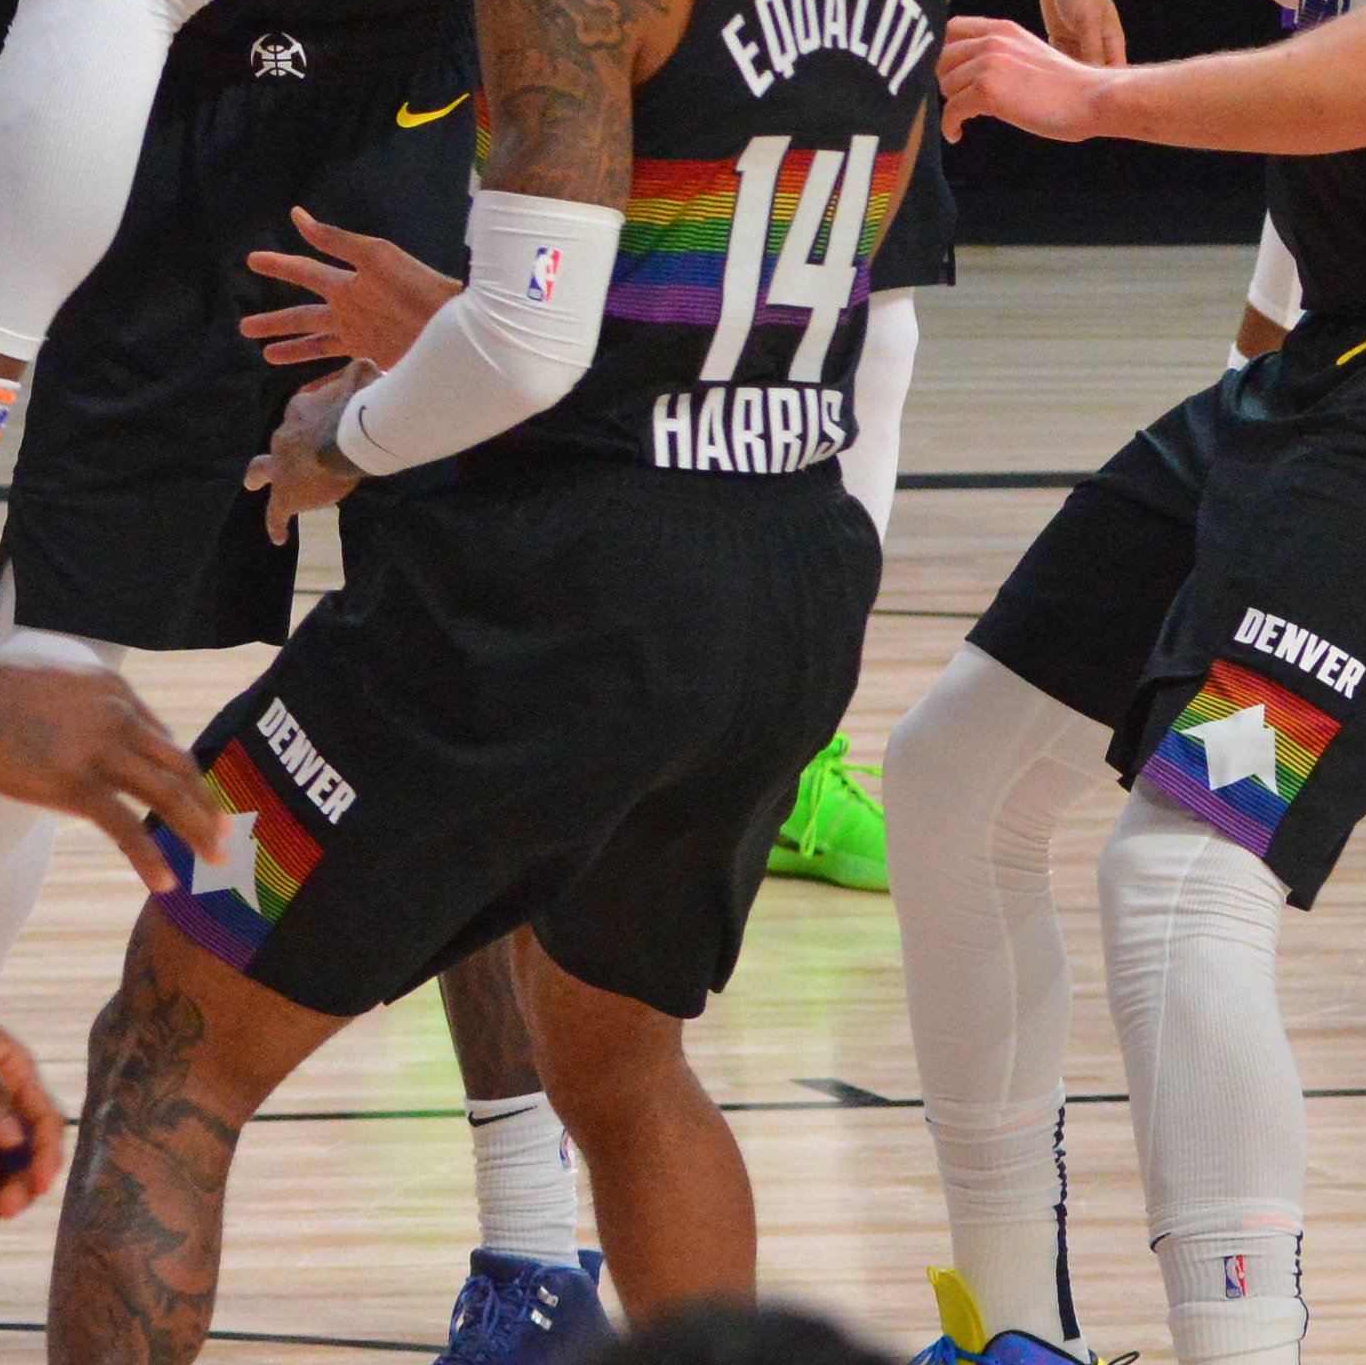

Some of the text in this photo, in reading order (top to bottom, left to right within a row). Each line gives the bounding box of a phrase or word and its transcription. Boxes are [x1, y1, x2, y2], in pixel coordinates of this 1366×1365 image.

[699, 135, 880, 383] 14
[651, 386, 845, 475] HARRIS
[1233, 606, 1366, 700] DENVER
[255, 696, 357, 826] DENVER
